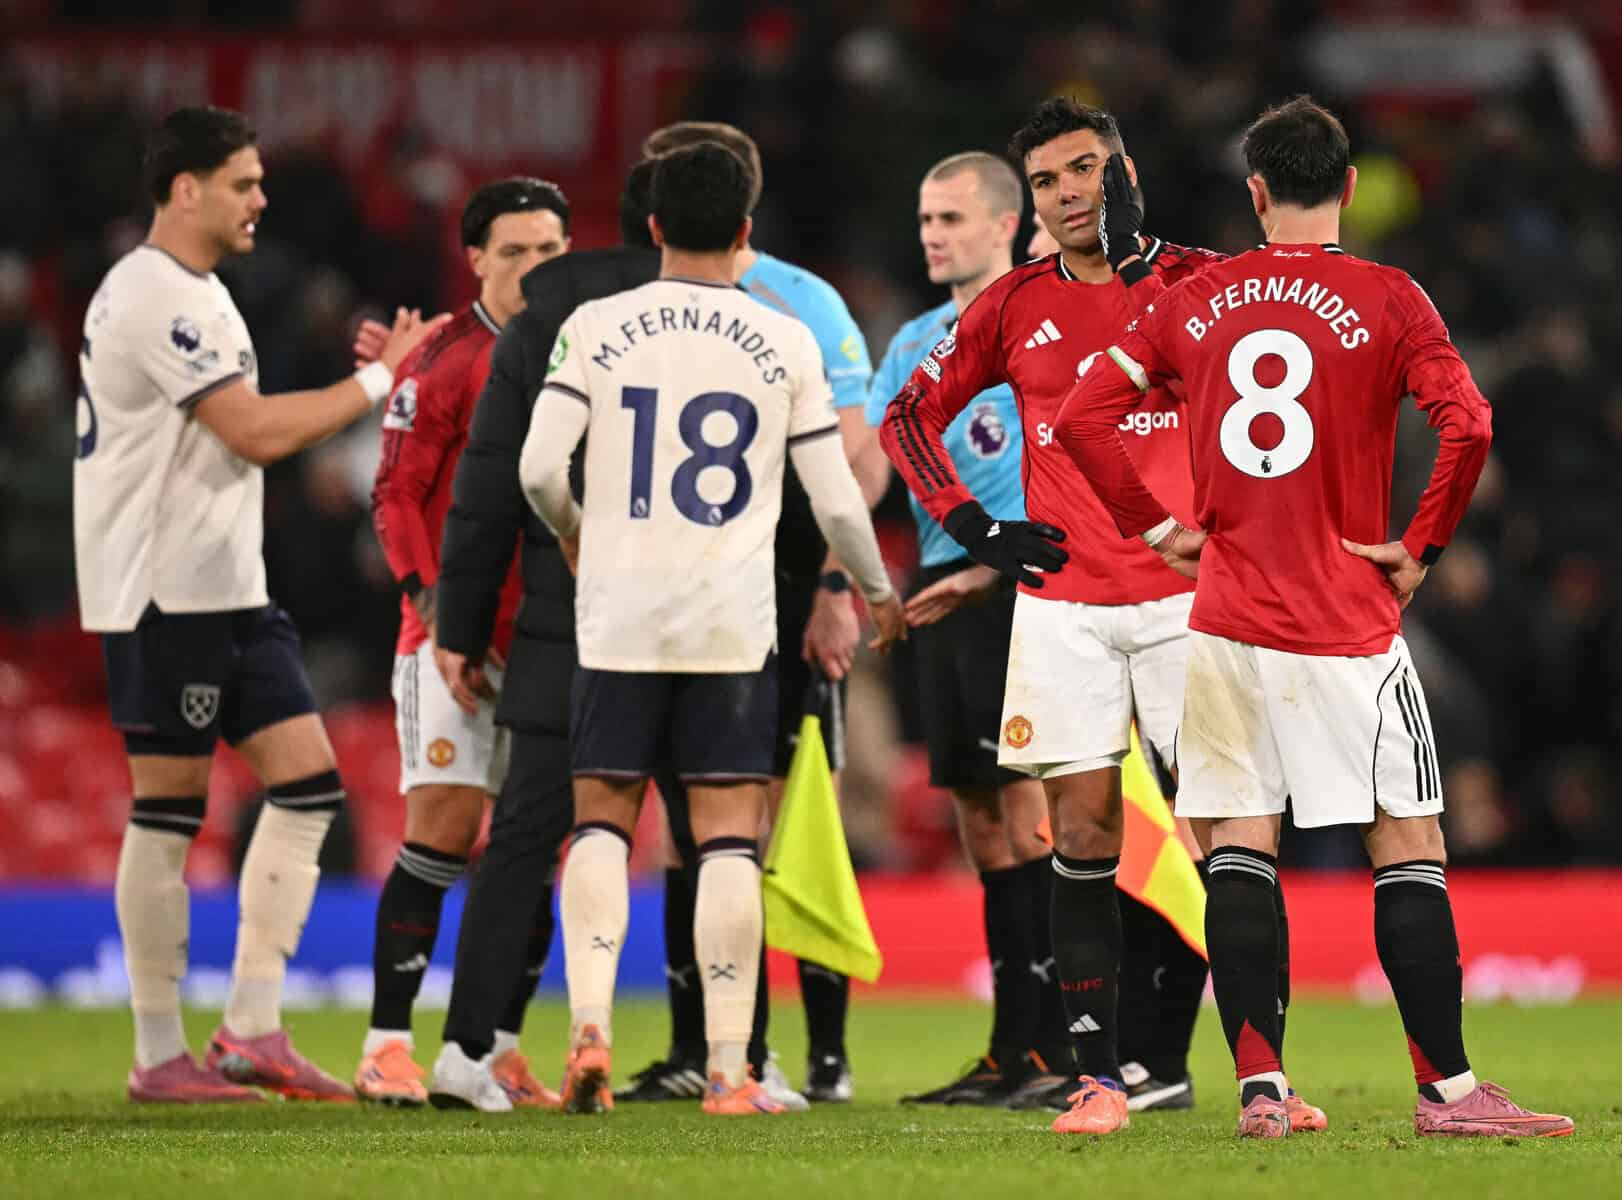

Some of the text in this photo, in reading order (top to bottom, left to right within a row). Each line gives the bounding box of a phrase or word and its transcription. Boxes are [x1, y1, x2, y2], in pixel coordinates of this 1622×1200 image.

[591, 306, 787, 385] M.FERNANDES
[1185, 277, 1370, 350] B.FERNANDES
[1036, 411, 1179, 447] Sagon
[1219, 328, 1315, 479] 8
[621, 385, 759, 528] 18
